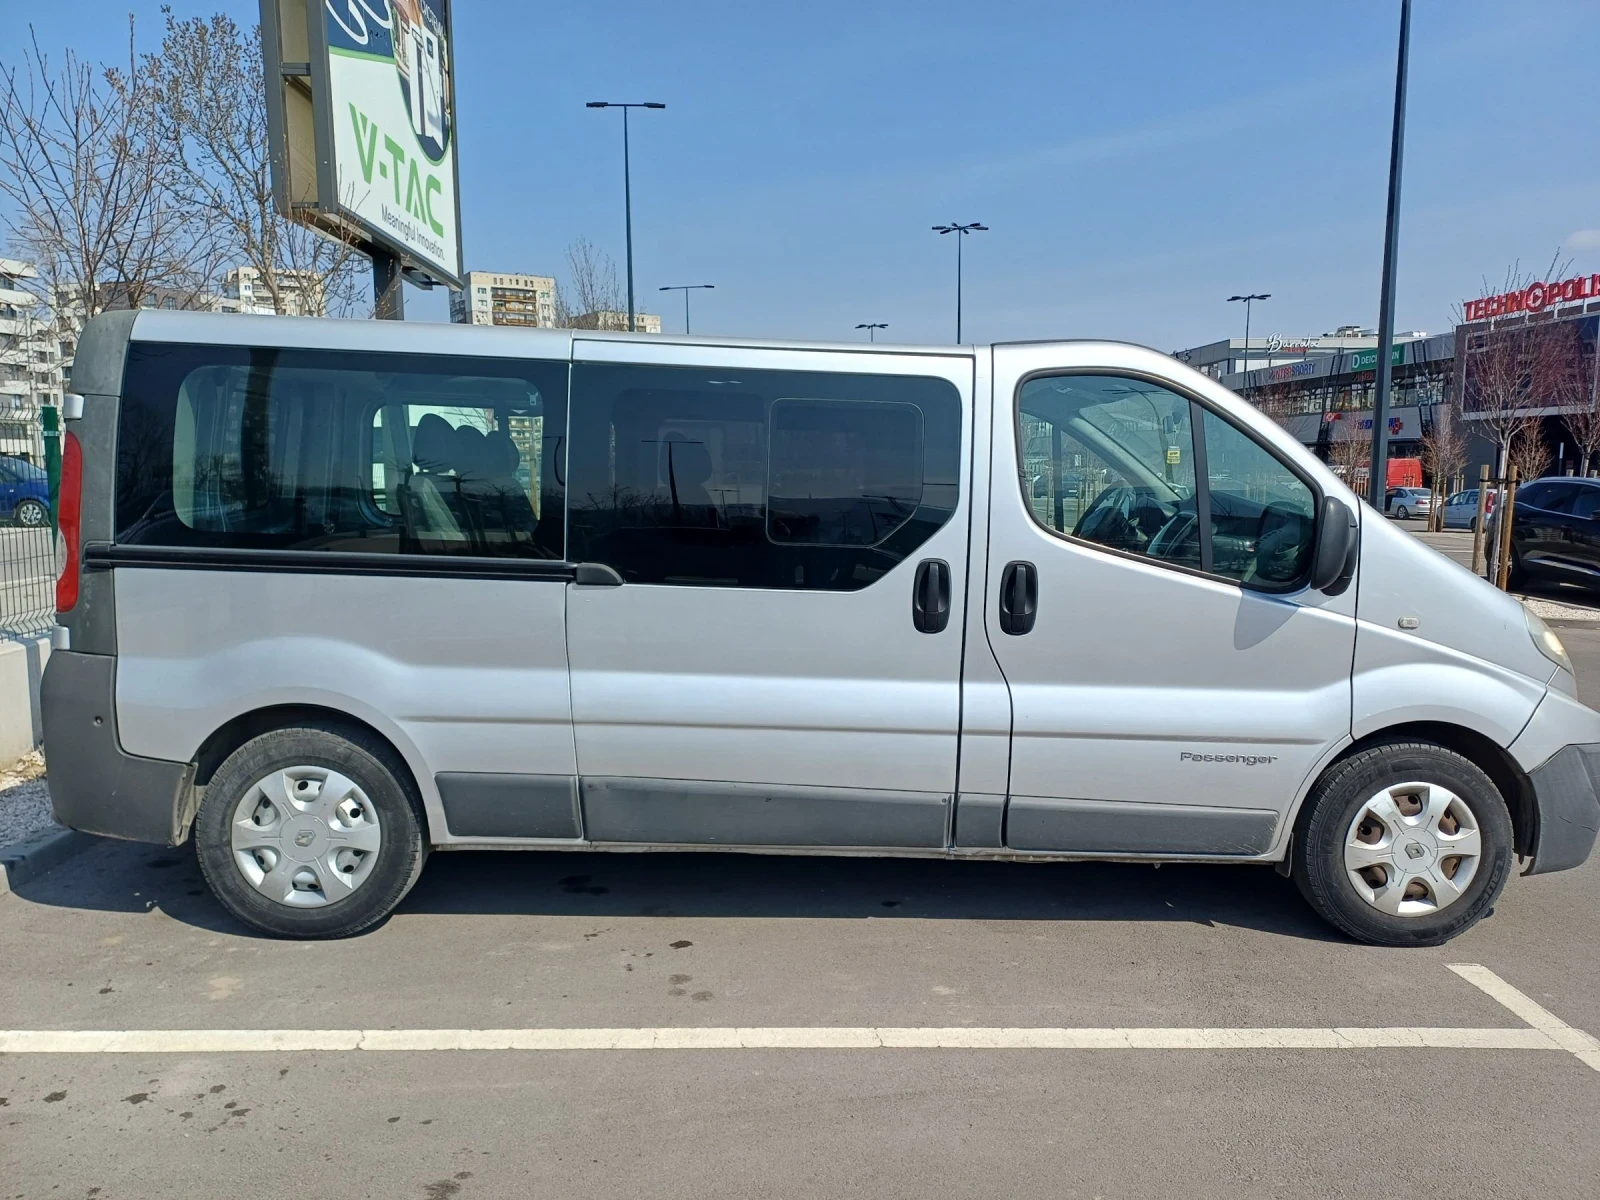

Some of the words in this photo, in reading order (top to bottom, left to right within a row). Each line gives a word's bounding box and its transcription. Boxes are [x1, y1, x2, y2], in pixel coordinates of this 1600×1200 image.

[348, 101, 444, 239] V-TAC
[381, 202, 416, 242] Meaningful
[1361, 350, 1400, 365] DEICNN
[1180, 751, 1278, 766] Passenger
